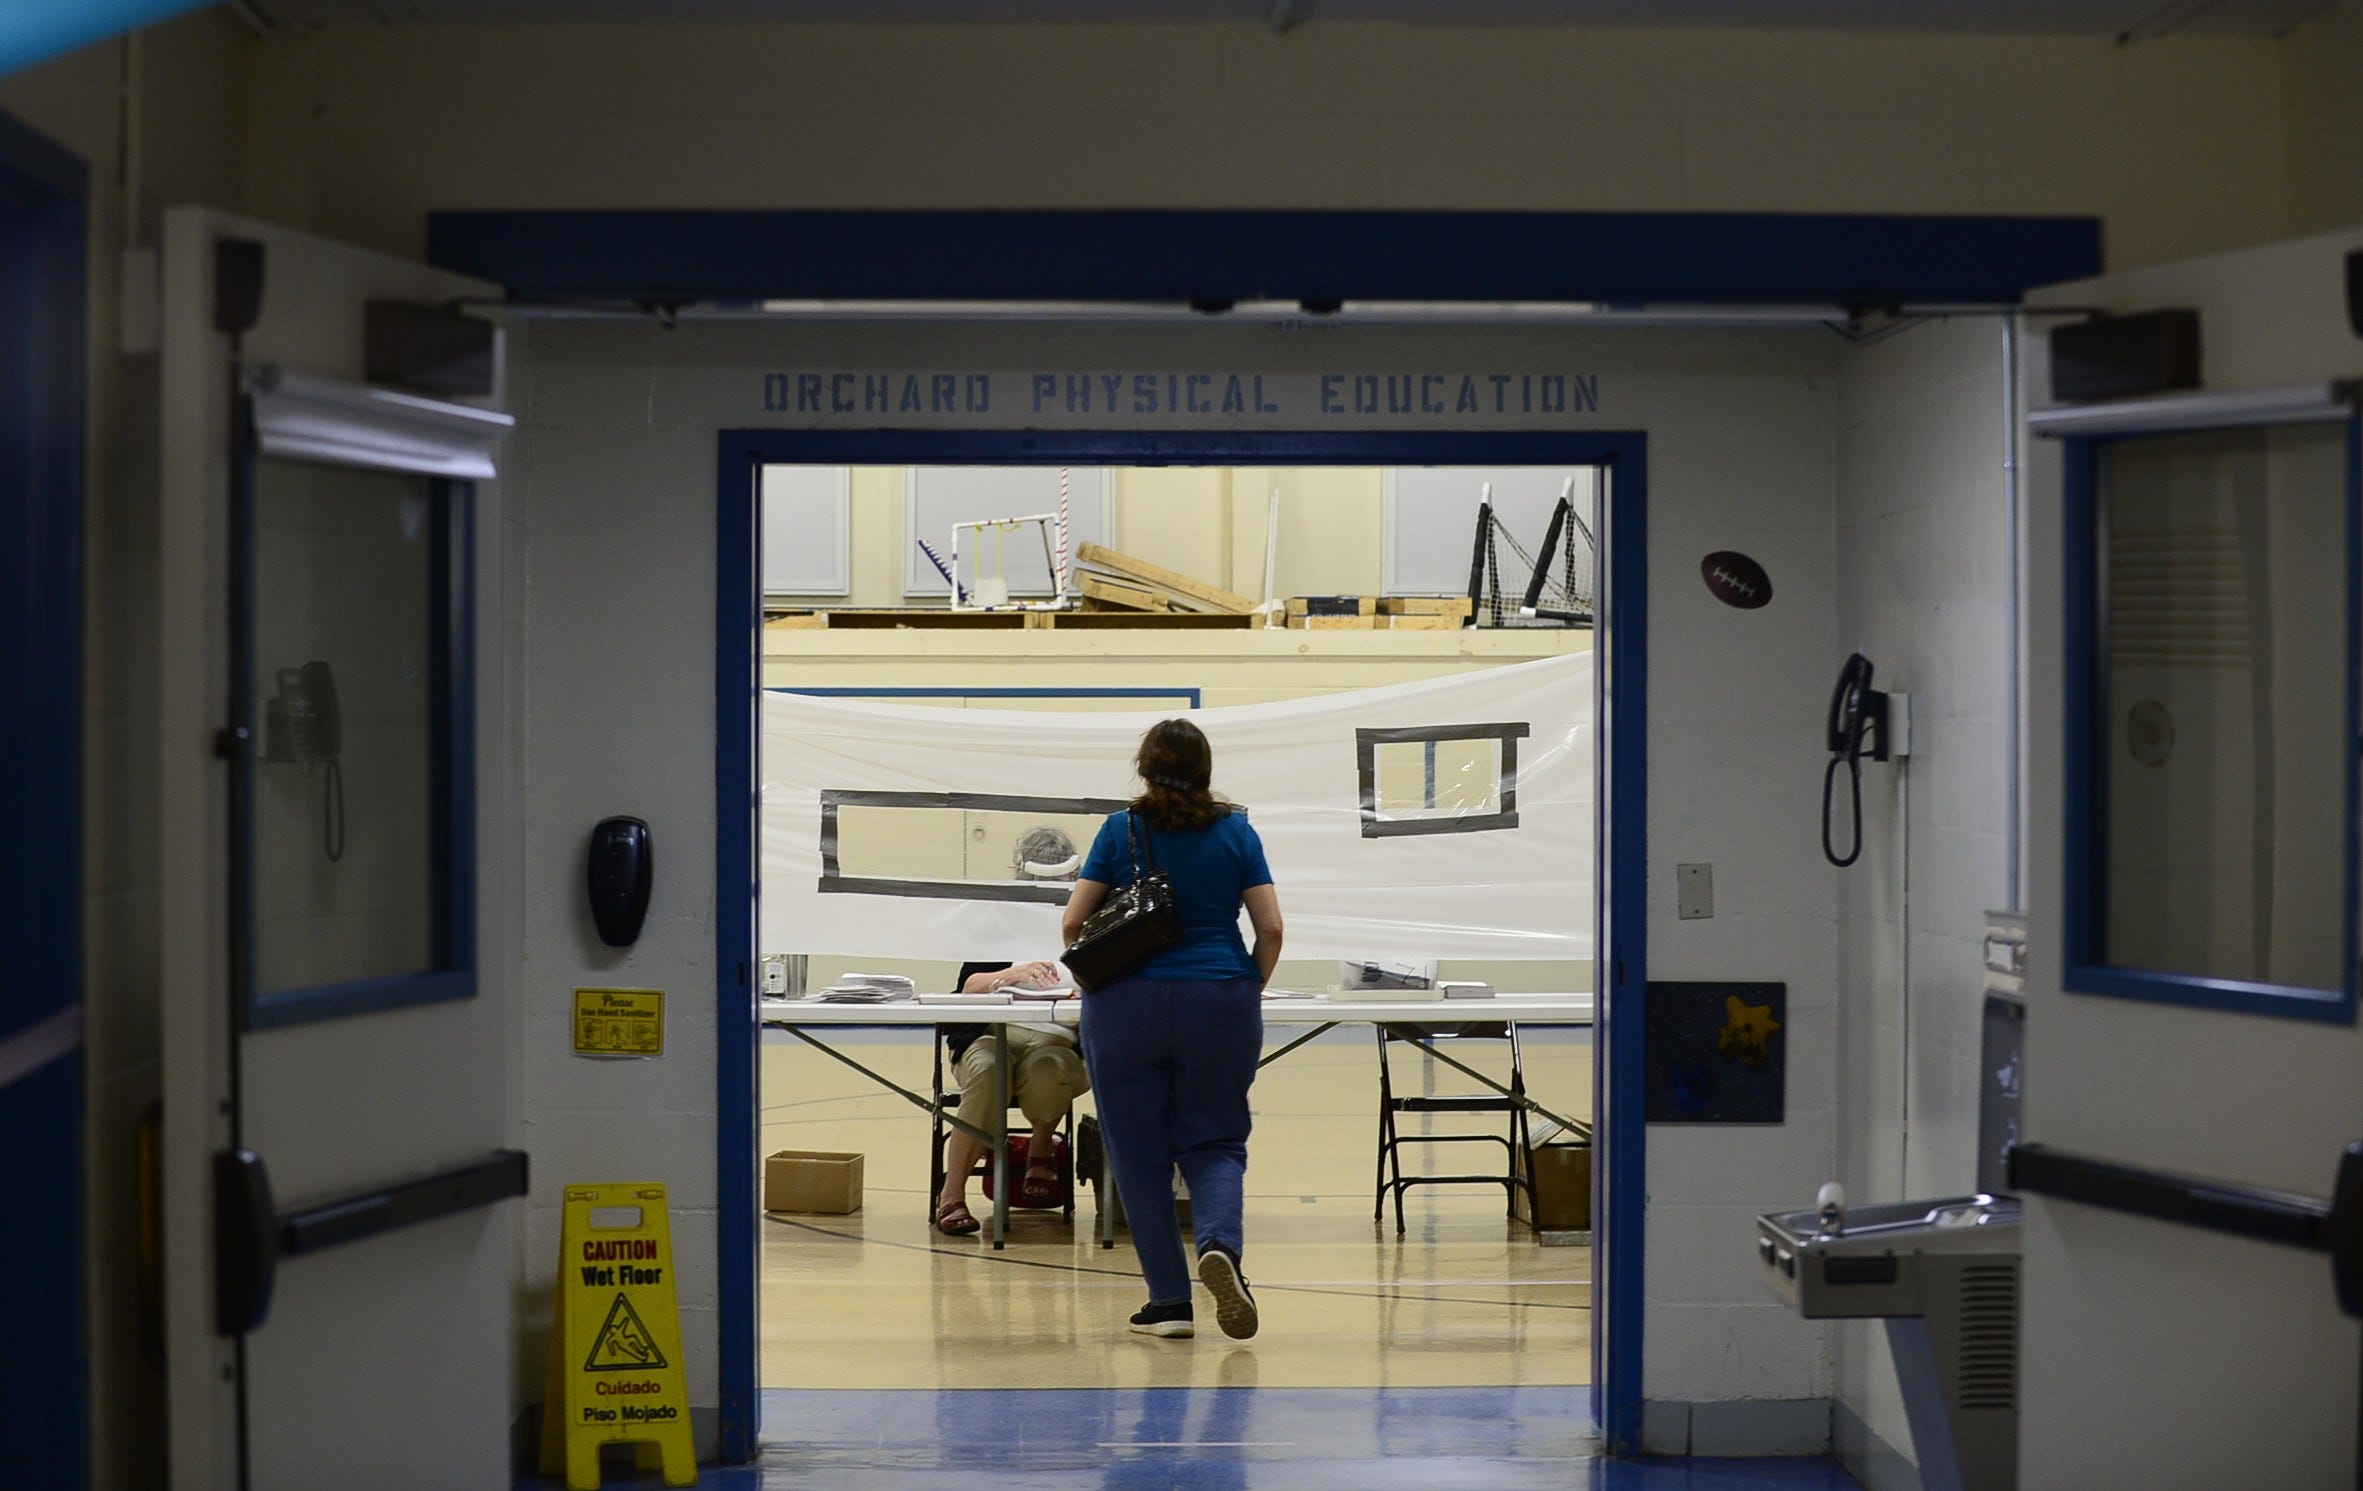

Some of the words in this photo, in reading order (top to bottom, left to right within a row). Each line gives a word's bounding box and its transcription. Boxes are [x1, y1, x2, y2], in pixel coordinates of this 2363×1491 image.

[763, 373, 990, 413] ORCHARD
[1032, 374, 1278, 413] PHYSICAL
[1320, 374, 1598, 413] EDUCATION
[602, 994, 633, 1007] Please
[580, 1008, 596, 1016] Use
[597, 1008, 618, 1017] Hand
[620, 1009, 655, 1018] Sanitizer
[583, 1240, 657, 1261] CAUTION
[581, 1267, 615, 1286] Wet
[619, 1265, 662, 1285] Floor
[595, 1380, 661, 1396] Cuidado
[583, 1407, 617, 1422] Piso
[621, 1404, 678, 1423] Mojado
